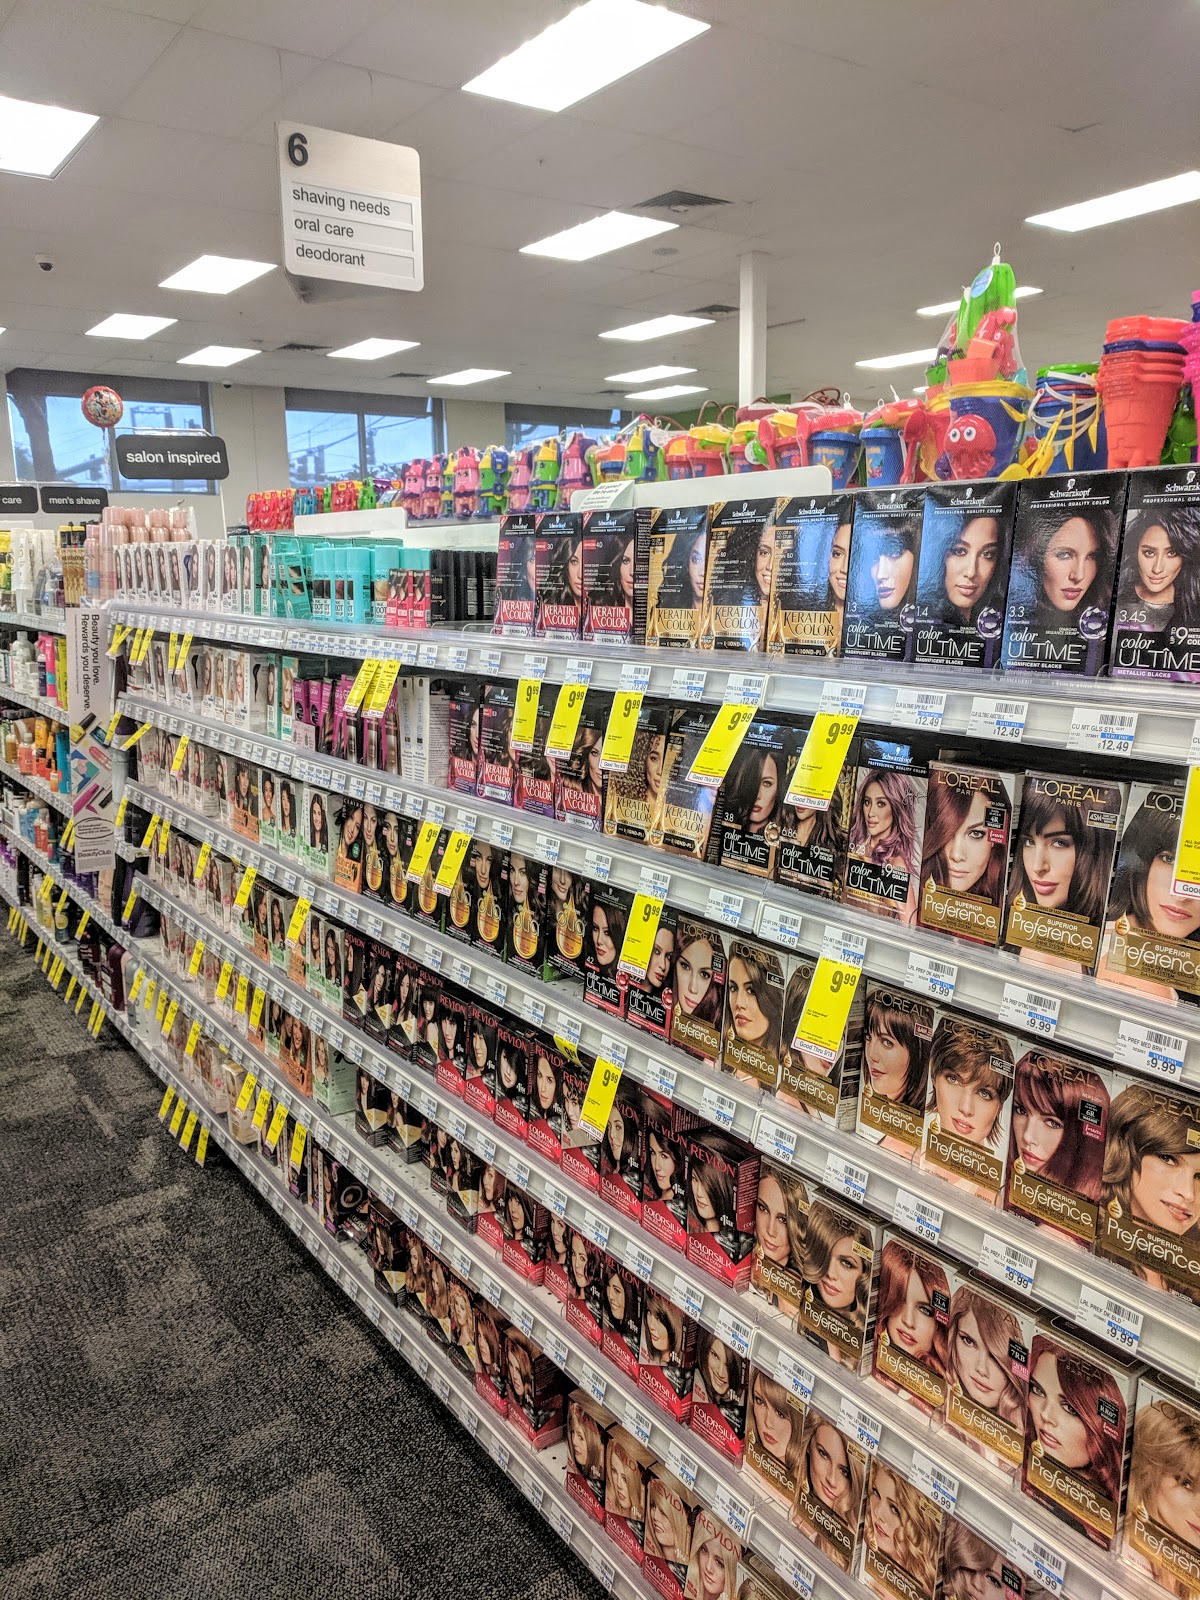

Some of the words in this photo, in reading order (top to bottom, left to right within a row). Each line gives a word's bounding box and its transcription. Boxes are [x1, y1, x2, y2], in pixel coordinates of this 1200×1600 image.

[288, 132, 309, 167] 6
[292, 187, 345, 212] shaving
[350, 199, 391, 217] needs
[294, 218, 320, 233] oral
[325, 223, 354, 238] care
[296, 244, 366, 267] deodorant
[126, 450, 164, 465] salon
[168, 451, 221, 467] inspired
[3, 496, 22, 505] care
[1049, 487, 1091, 499] Schwarzkopf
[1143, 495, 1187, 504] PROFESSIONAL
[49, 496, 75, 505] men's
[76, 496, 100, 506] shave
[877, 502, 909, 511] Schwarzkopf
[950, 498, 986, 507] Schwarzkopf
[502, 600, 532, 618] KERATIN
[508, 609, 532, 622] COLOR
[544, 605, 575, 620] KERATIN
[592, 606, 626, 621] KERATIN
[658, 608, 694, 622] KERATIN
[715, 606, 759, 622] KERATIN
[916, 605, 929, 617] 1.4
[1008, 605, 1025, 618] 3.3
[1119, 610, 1147, 623] 3.45
[551, 614, 577, 627] COLOR
[599, 616, 628, 629] COLOR
[665, 618, 697, 632] COLOR
[724, 617, 760, 631] COLOR
[784, 611, 832, 626] KERATIN
[81, 614, 90, 654] Rewards
[91, 614, 100, 645] Beauty
[796, 622, 835, 638] COLOR
[847, 620, 869, 634] color
[918, 625, 943, 640] color
[1009, 626, 1039, 643] color
[1120, 632, 1155, 650] color
[1176, 626, 1188, 646] 9
[81, 655, 89, 671] you
[1007, 660, 1040, 669] MAGNIFICENT
[93, 666, 101, 686] love.
[1117, 669, 1147, 679] METALLIC
[1148, 671, 1172, 680] BLACKS
[83, 674, 91, 711] deserve.
[915, 716, 939, 728] $12.49
[1091, 725, 1103, 733] GLS
[993, 727, 1020, 739] $12.49
[1097, 739, 1129, 753] $12.49
[881, 753, 913, 764] Schwarzkopf
[523, 776, 551, 792] KERATIN
[529, 786, 552, 800] COLOR
[564, 788, 595, 803] KERATIN
[955, 787, 978, 797] PARIS
[571, 800, 598, 814] COLOR
[617, 798, 650, 814] KERATIN
[1055, 797, 1082, 808] PARIS
[624, 808, 652, 823] COLOR
[724, 830, 742, 842] color
[782, 845, 802, 859] color
[850, 863, 872, 877] color
[1182, 883, 1200, 895] Goo
[954, 900, 983, 912] SUPERIOR
[1047, 918, 1078, 932] SUPERIOR
[1154, 944, 1191, 959] SUPERIOR
[586, 970, 600, 982] color
[630, 988, 644, 1001] color
[928, 983, 950, 998] $9.99
[1026, 1018, 1051, 1034] $9.99
[498, 1028, 528, 1052] REVLON
[1127, 1036, 1140, 1046] PREF
[1140, 1040, 1152, 1050] MED
[1146, 1057, 1177, 1076] $9.99
[804, 1075, 825, 1089] SUPERIOR
[888, 1107, 913, 1121] SUPERIOR
[529, 1123, 561, 1150] COLORSILK
[646, 1112, 688, 1149] REVLON
[691, 1143, 737, 1178] REVLON
[958, 1145, 986, 1161] SUPERIOR
[562, 1150, 598, 1179] COLORSILK
[600, 1175, 639, 1208] COLORSILK
[843, 1186, 862, 1201] $9.99
[1045, 1187, 1077, 1207] SUPERIOR
[642, 1203, 684, 1236] COLORSILK
[915, 1225, 936, 1241] $9.99
[1146, 1232, 1183, 1253] SUPERIOR
[688, 1235, 733, 1271] COLORSILK
[1004, 1271, 1030, 1290] $9.99
[1090, 1303, 1103, 1316] PREF
[1106, 1327, 1135, 1348] $9.99
[1011, 1349, 1026, 1364] 7RB
[639, 1365, 679, 1405] COLORSILK
[791, 1381, 808, 1399] $9.99
[692, 1403, 737, 1446] COLORSILK
[856, 1432, 875, 1450] $9.99
[1064, 1475, 1096, 1499] SUPERIOR
[931, 1490, 951, 1510] $9.99
[697, 1514, 742, 1562] REVLON
[1033, 1568, 1058, 1591] $9.99
